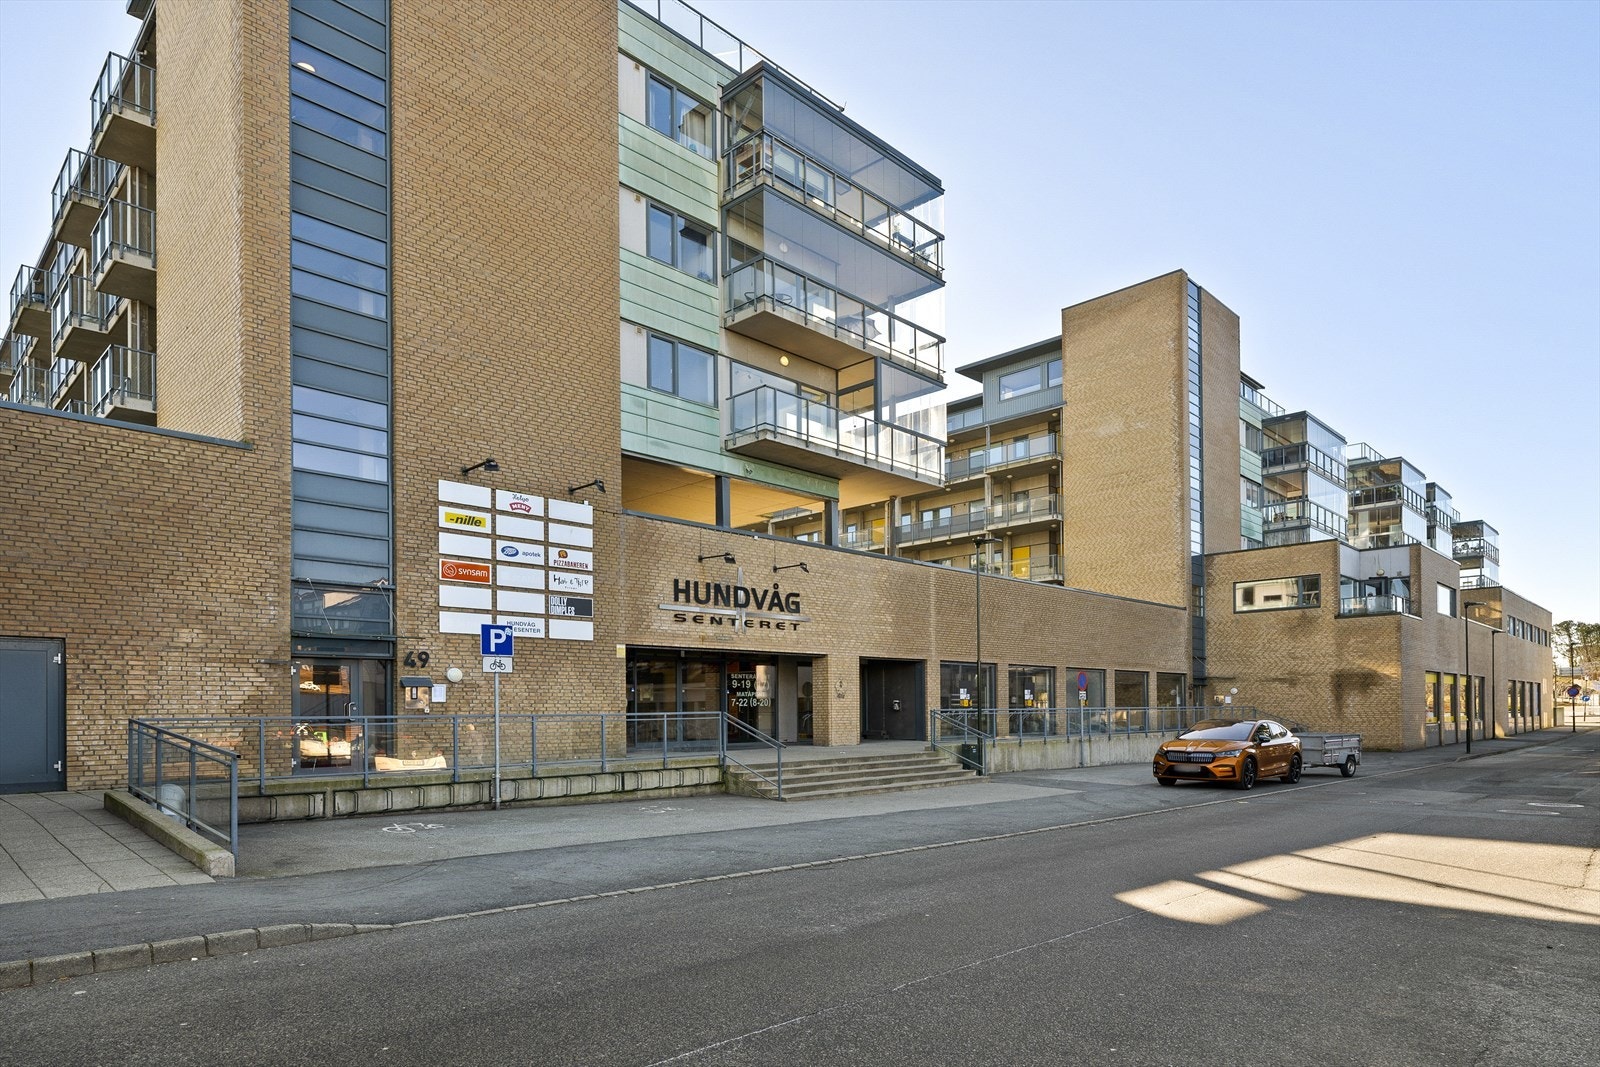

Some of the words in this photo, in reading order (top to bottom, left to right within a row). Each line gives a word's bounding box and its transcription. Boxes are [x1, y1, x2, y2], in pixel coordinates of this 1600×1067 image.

[550, 596, 568, 606] DOLLY
[674, 578, 800, 614] HUNDVÅG
[550, 606, 576, 615] DIMPLES
[674, 614, 800, 631] SENTERET
[490, 628, 506, 652] P
[404, 651, 430, 668] 49
[732, 680, 750, 688] 9-19
[732, 698, 748, 706] 7-22
[750, 698, 771, 707] (8-20)
